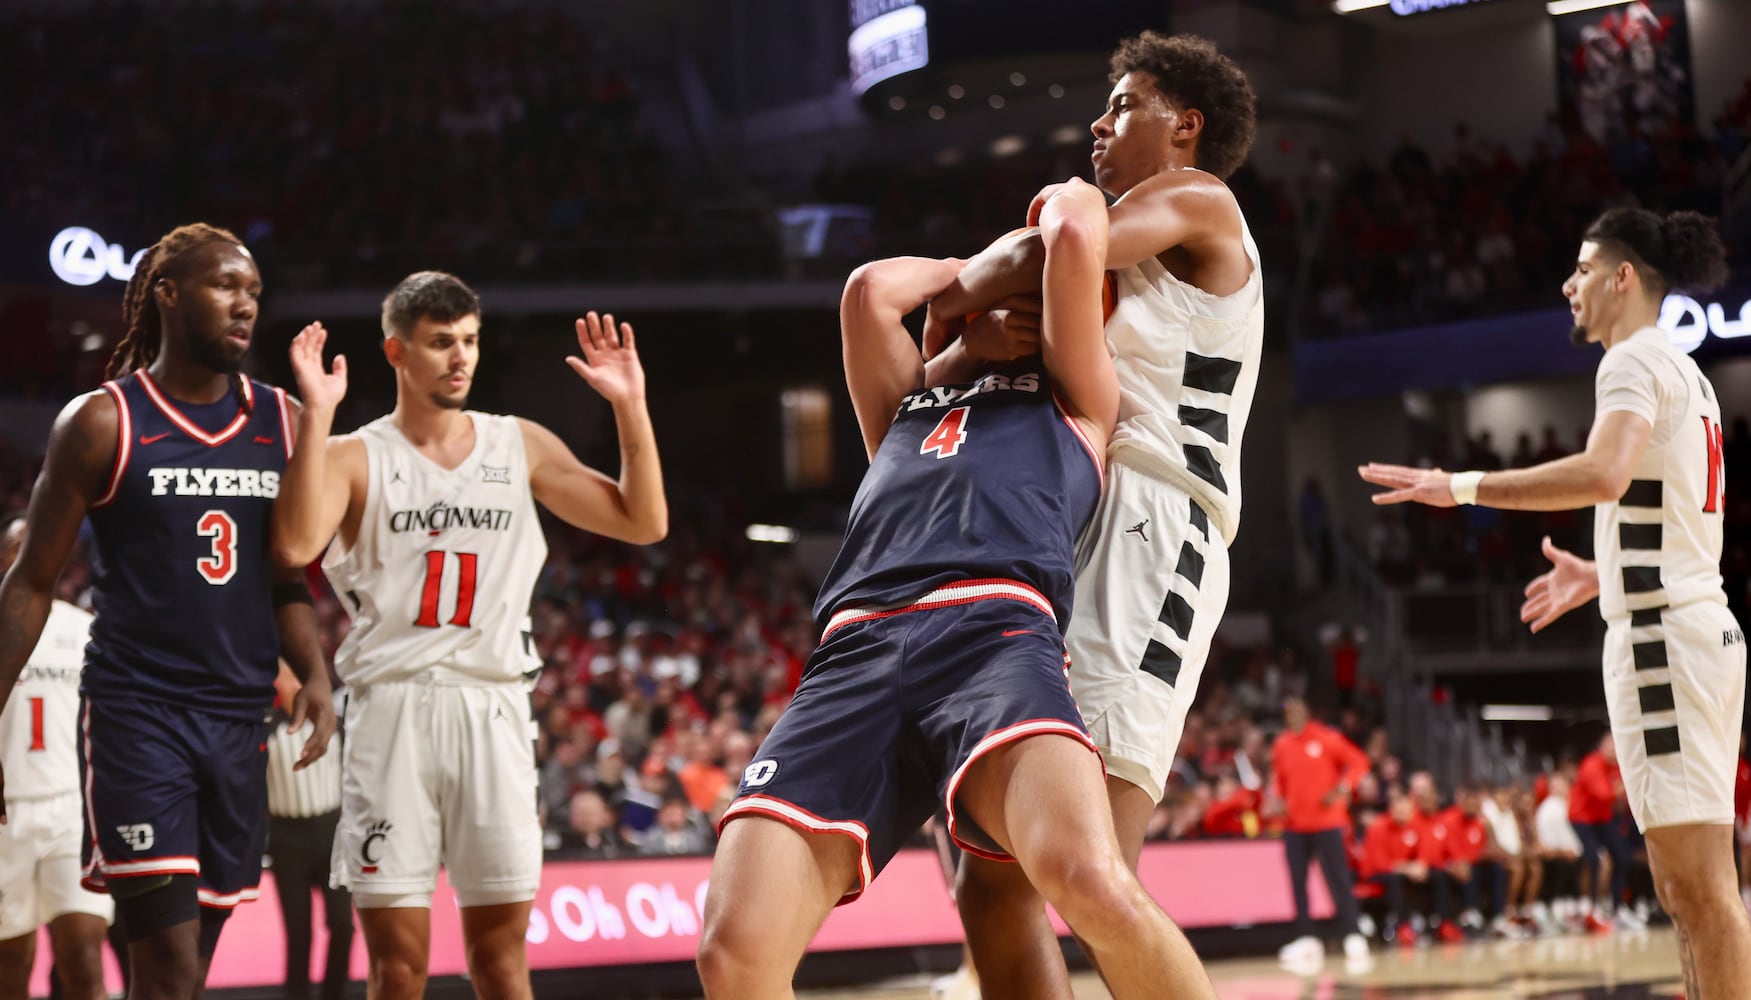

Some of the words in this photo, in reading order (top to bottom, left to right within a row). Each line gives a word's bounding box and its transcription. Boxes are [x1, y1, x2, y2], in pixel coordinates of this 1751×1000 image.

[1707, 302, 1751, 339] L
[920, 406, 972, 459] 4
[148, 467, 280, 499] FLYERS
[390, 501, 512, 536] CINCINNATI
[197, 509, 237, 585] 3
[413, 550, 477, 628] 11
[29, 697, 45, 752] 1
[550, 885, 626, 943] Oh
[624, 881, 699, 938] Oh
